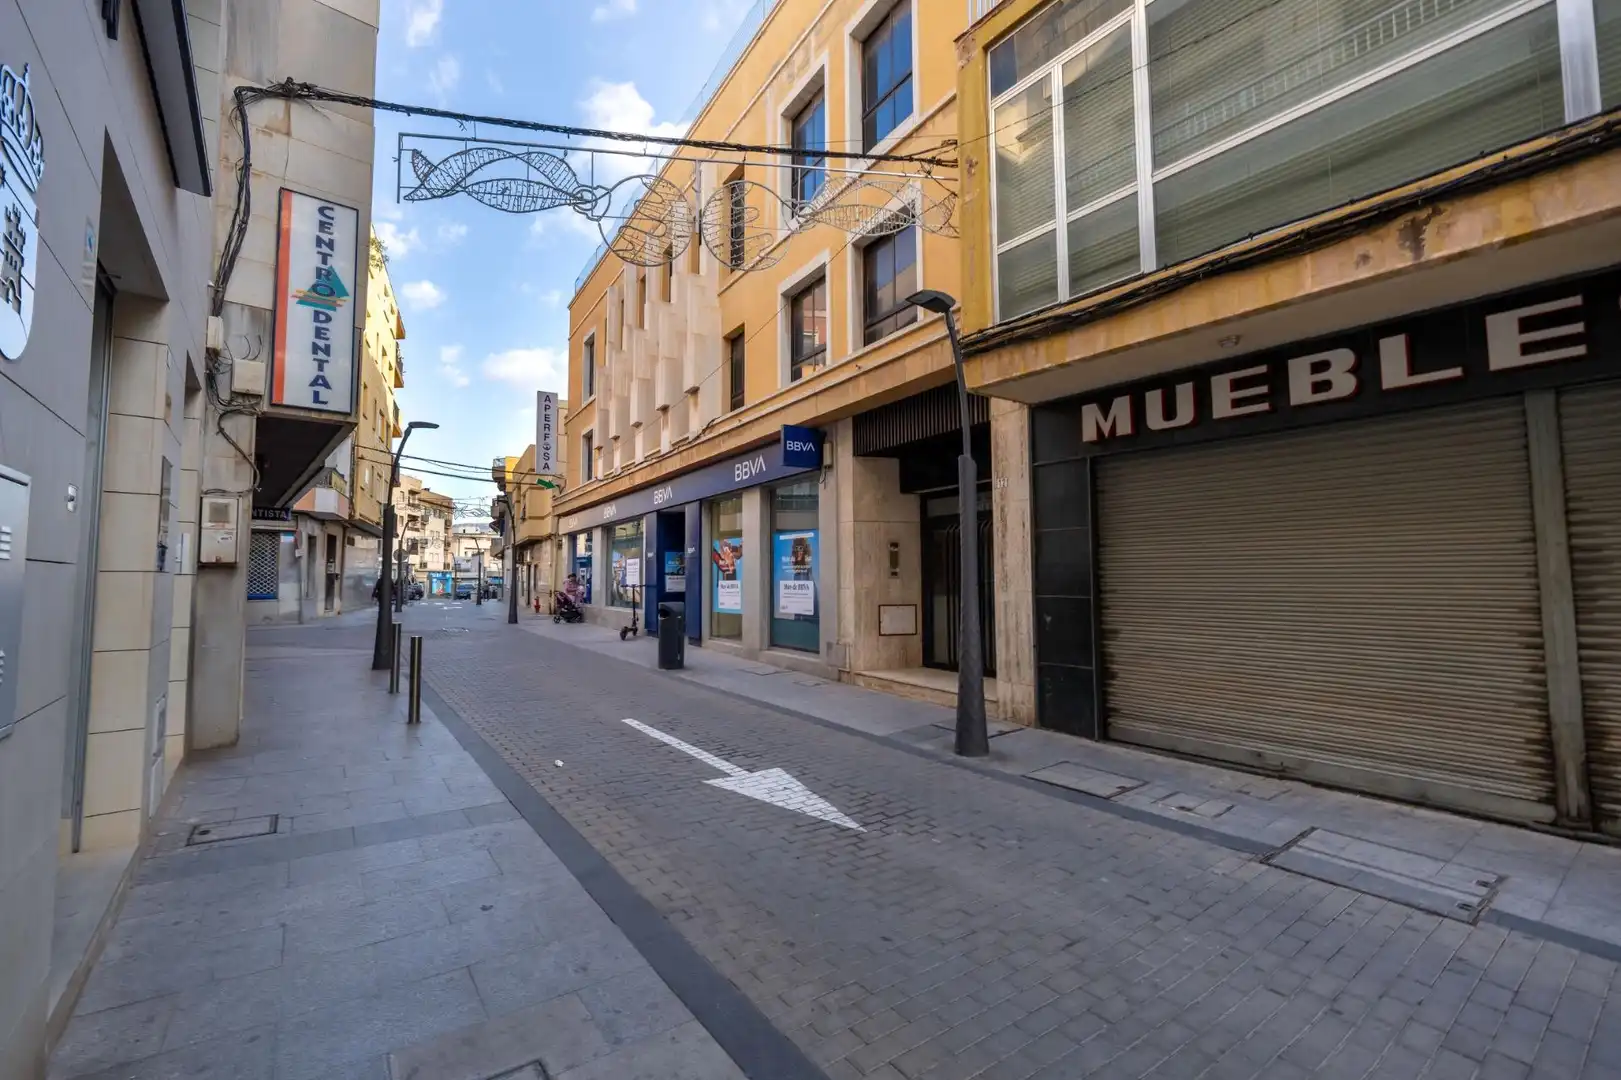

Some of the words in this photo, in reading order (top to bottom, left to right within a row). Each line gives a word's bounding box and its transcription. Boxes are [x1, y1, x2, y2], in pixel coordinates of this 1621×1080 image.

[312, 205, 336, 297] CENTRO
[308, 309, 333, 406] DENTAL
[1081, 293, 1621, 443] MUEBLE
[735, 454, 766, 482] BBVA
[786, 440, 816, 452] BBVA
[653, 485, 673, 505] BBVA
